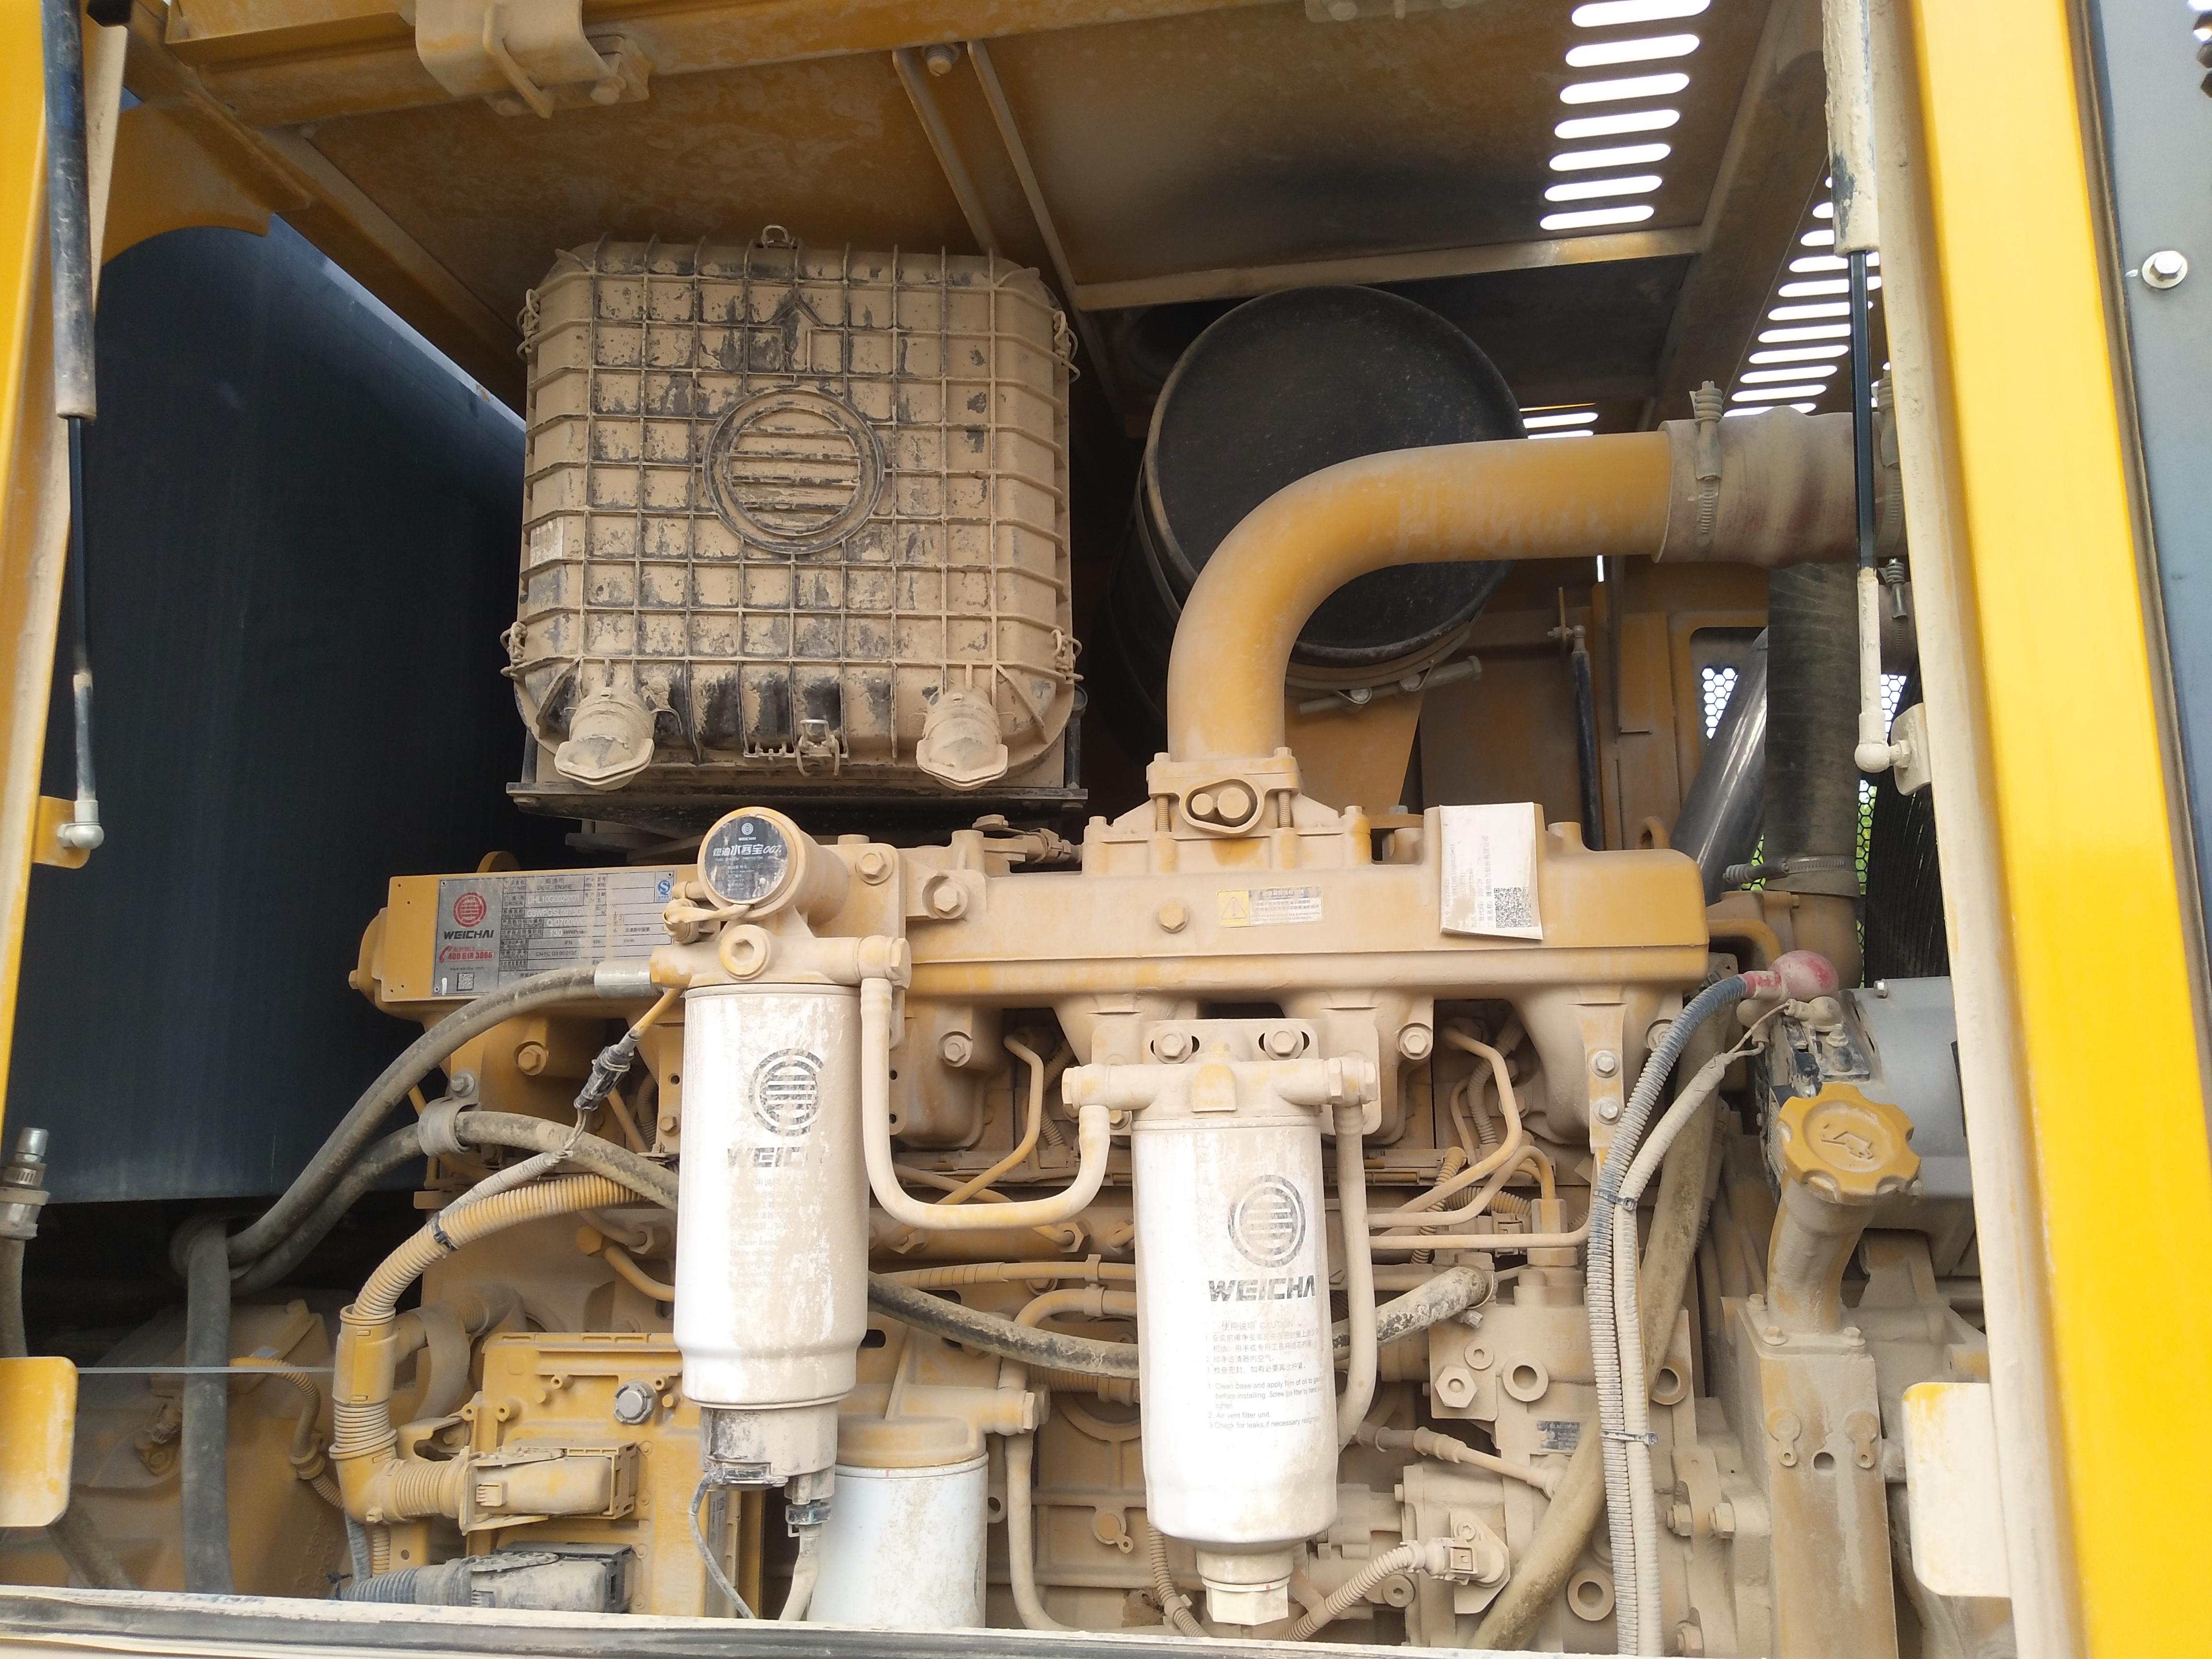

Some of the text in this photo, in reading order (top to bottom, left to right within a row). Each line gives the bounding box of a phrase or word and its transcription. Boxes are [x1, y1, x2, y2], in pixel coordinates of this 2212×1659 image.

[444, 930, 494, 939] WEICHAI
[1222, 1322, 1255, 1331] 使用说明
[1267, 1381, 1283, 1389] apply
[1271, 1419, 1300, 1427] necessary
